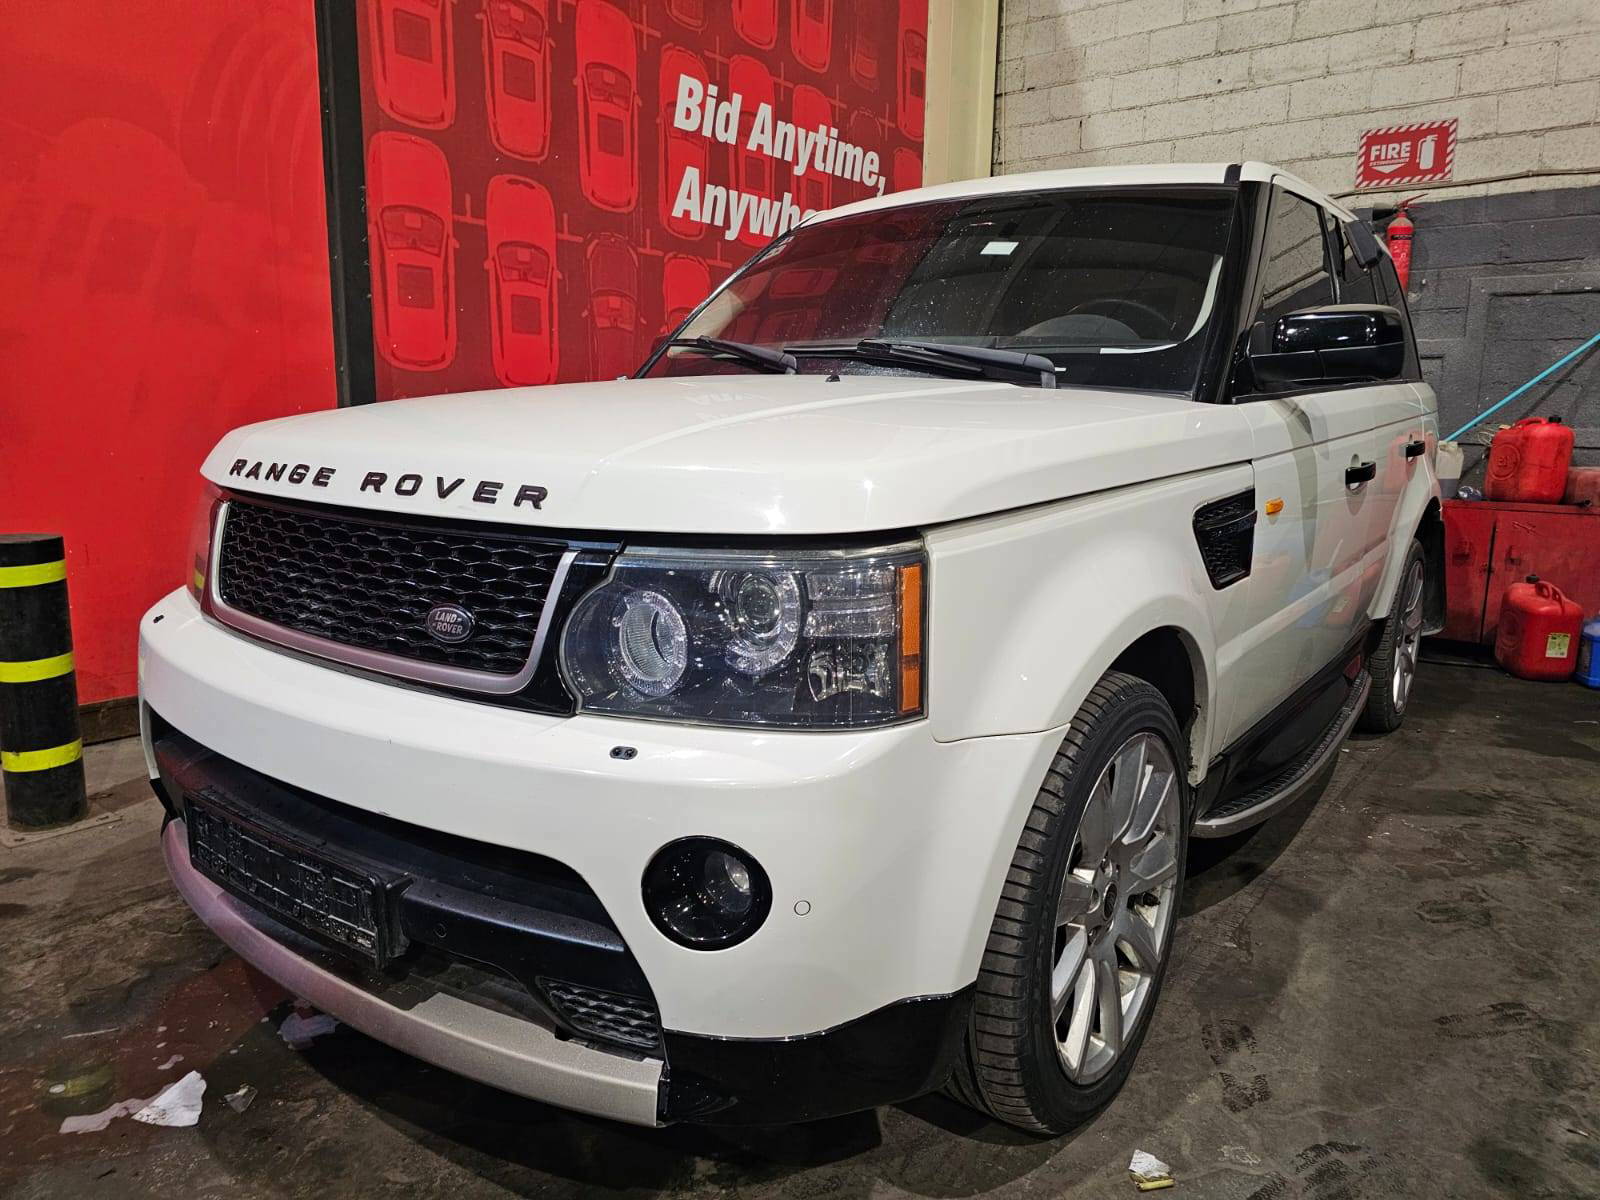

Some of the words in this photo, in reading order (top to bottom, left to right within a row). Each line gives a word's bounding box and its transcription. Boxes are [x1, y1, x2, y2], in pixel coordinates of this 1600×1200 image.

[673, 73, 743, 146] Bid
[746, 102, 886, 198] Anytime,
[1370, 141, 1412, 162] FIRE
[229, 458, 336, 488] RANGE
[359, 471, 549, 510] ROVER
